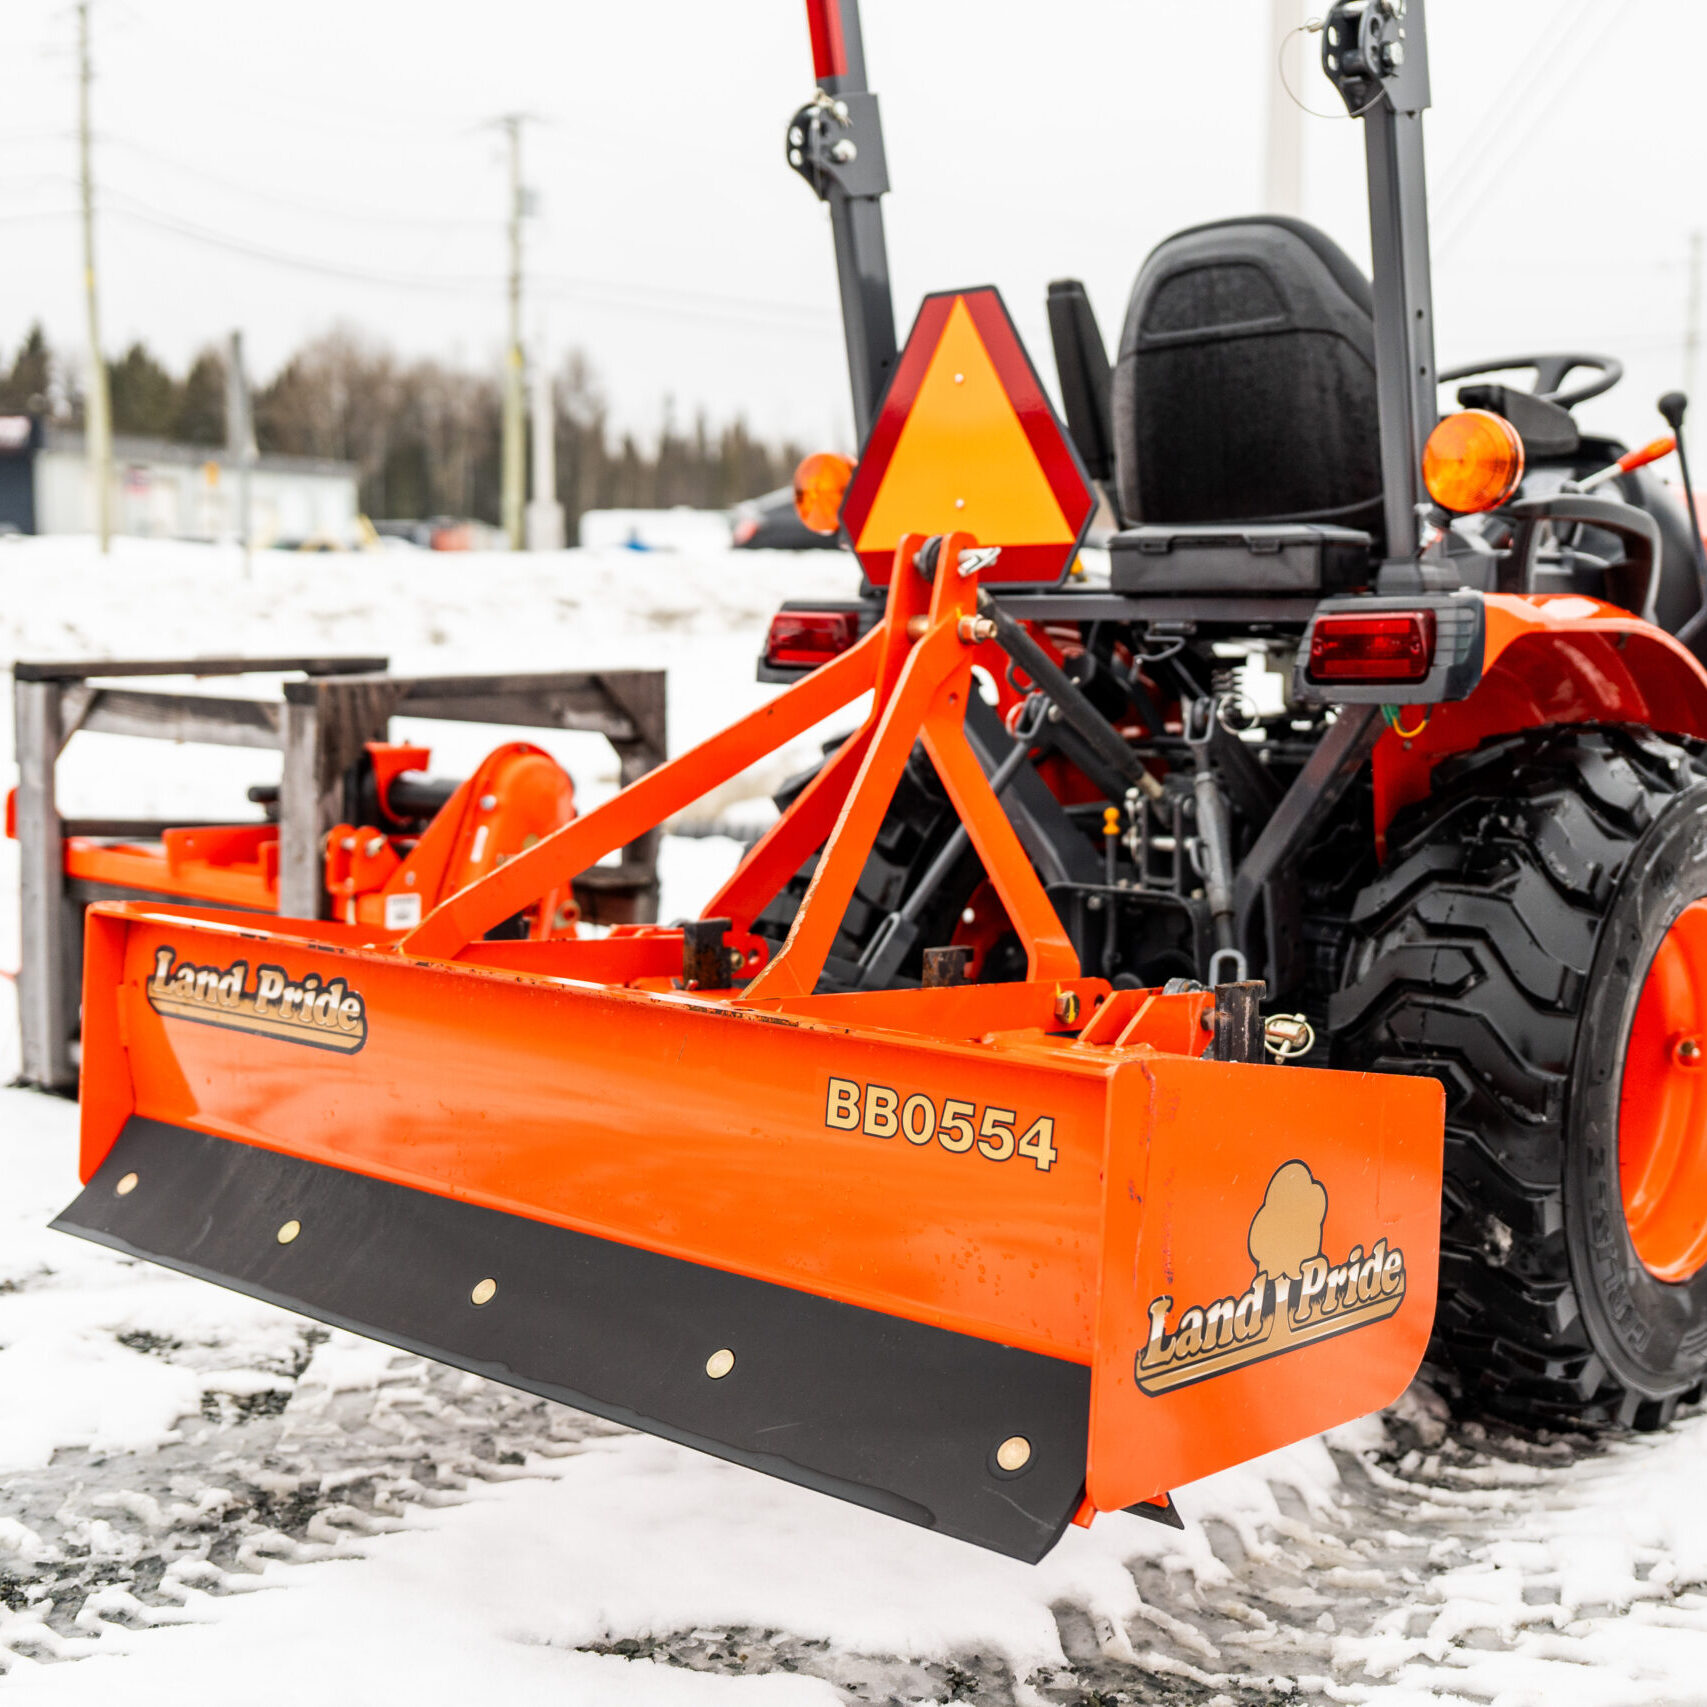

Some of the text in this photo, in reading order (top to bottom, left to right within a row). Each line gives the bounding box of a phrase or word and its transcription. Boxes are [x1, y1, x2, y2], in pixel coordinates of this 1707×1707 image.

[152, 946, 363, 1030] Land Pride
[825, 1077, 1058, 1172] BB0554
[1141, 1238, 1405, 1369] Land Pride
